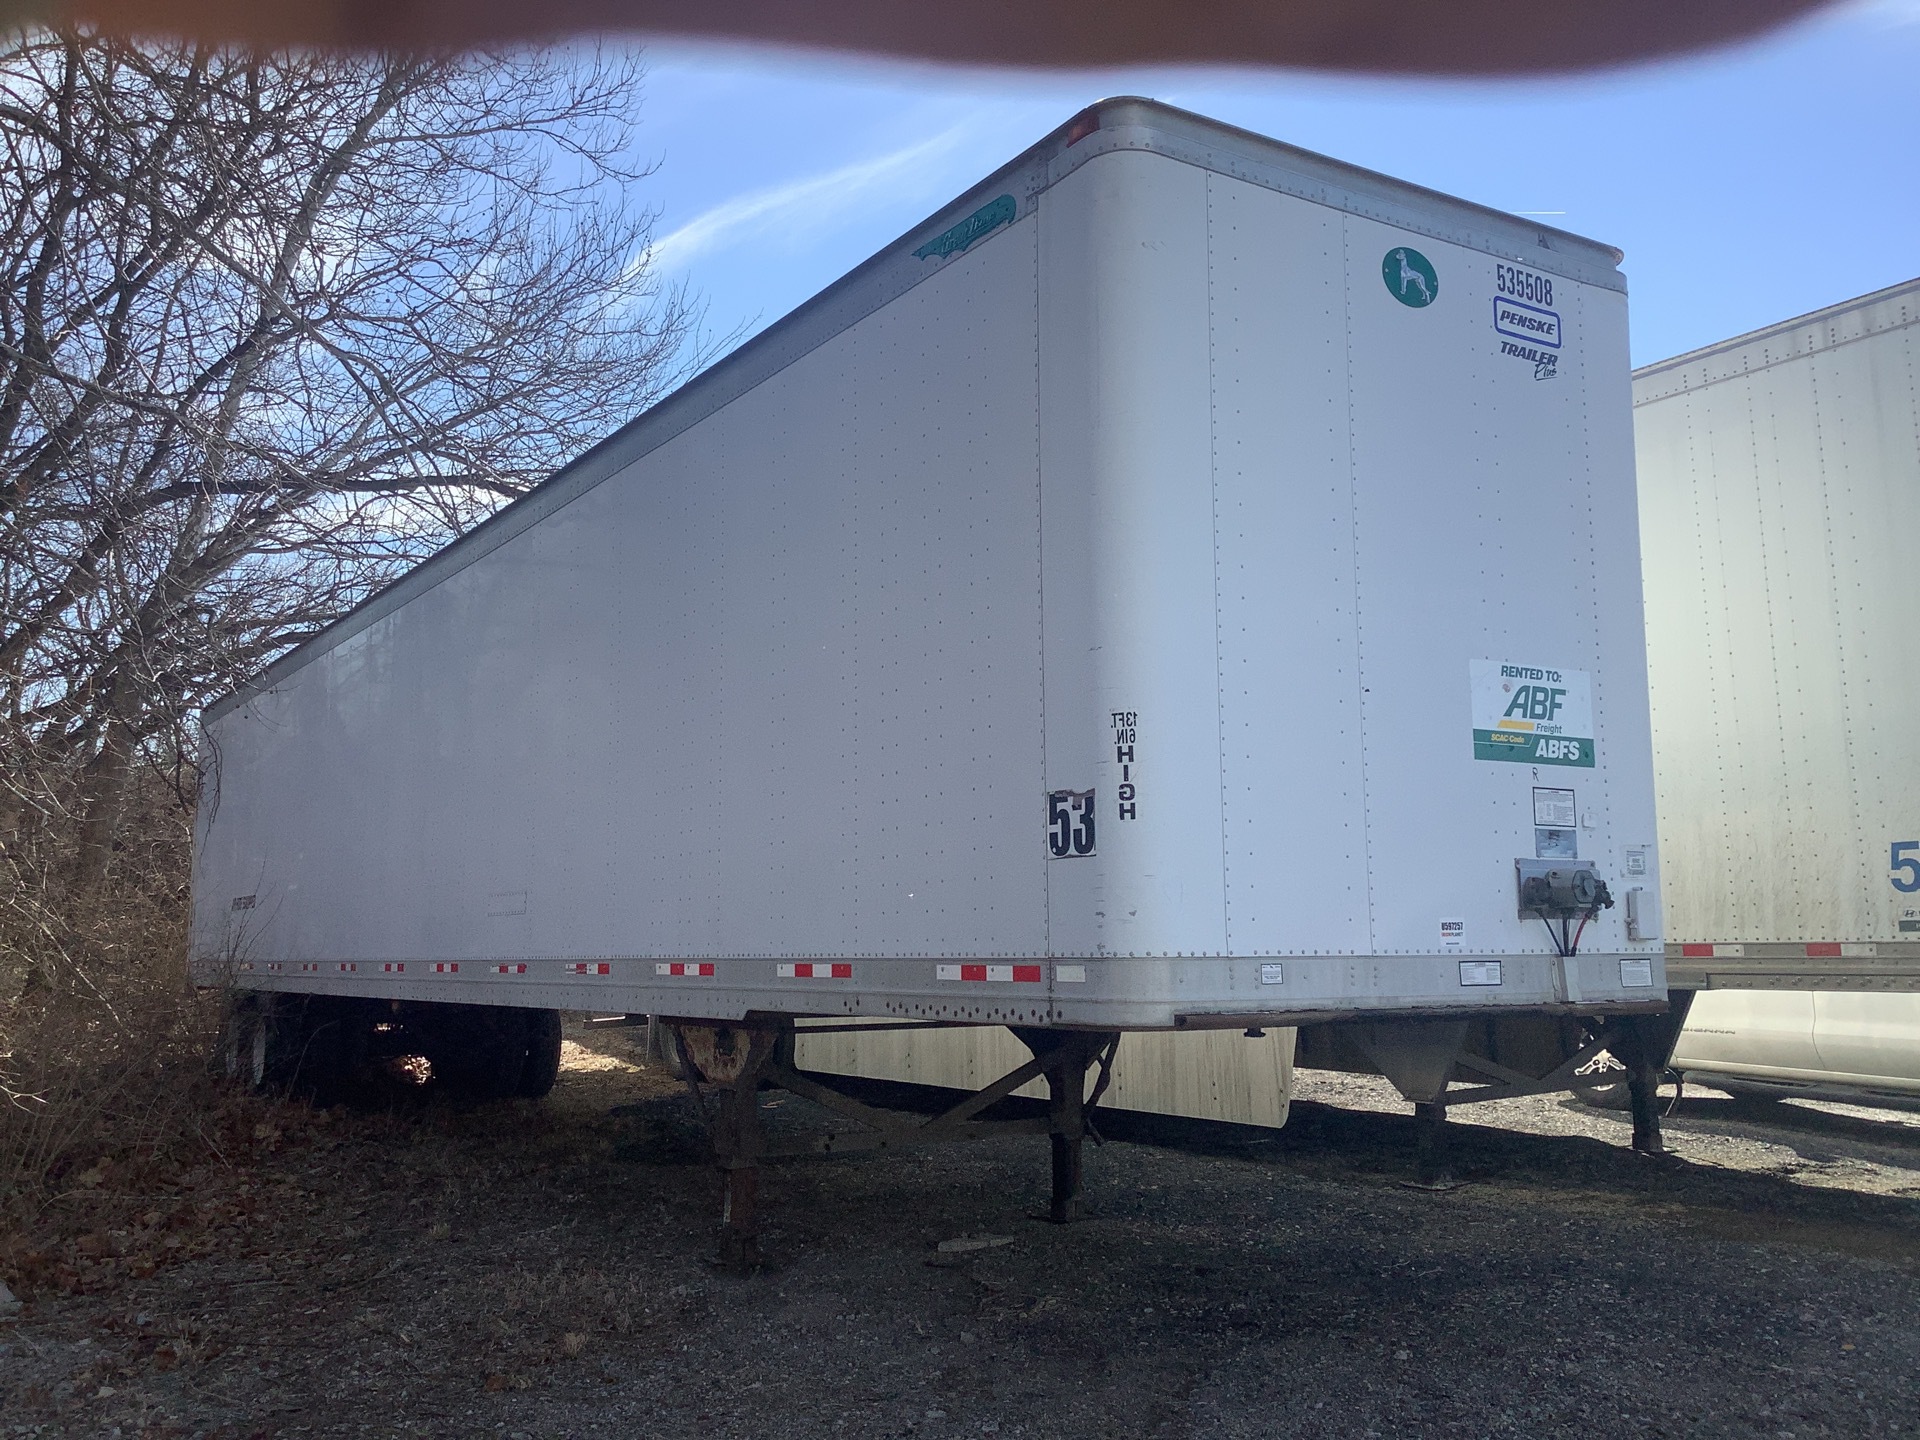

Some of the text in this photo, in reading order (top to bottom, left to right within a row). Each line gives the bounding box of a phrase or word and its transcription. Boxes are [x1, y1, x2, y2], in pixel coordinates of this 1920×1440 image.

[1497, 263, 1553, 306] 535508
[1500, 310, 1556, 335] PENSKE
[1500, 340, 1558, 367] TRAILER
[1534, 361, 1558, 381] Plus
[1501, 665, 1562, 683] RENTED TO:
[1503, 685, 1567, 721] ABF
[1536, 723, 1562, 734] Freight
[1535, 739, 1580, 761] ABFS
[1049, 792, 1095, 857] 53
